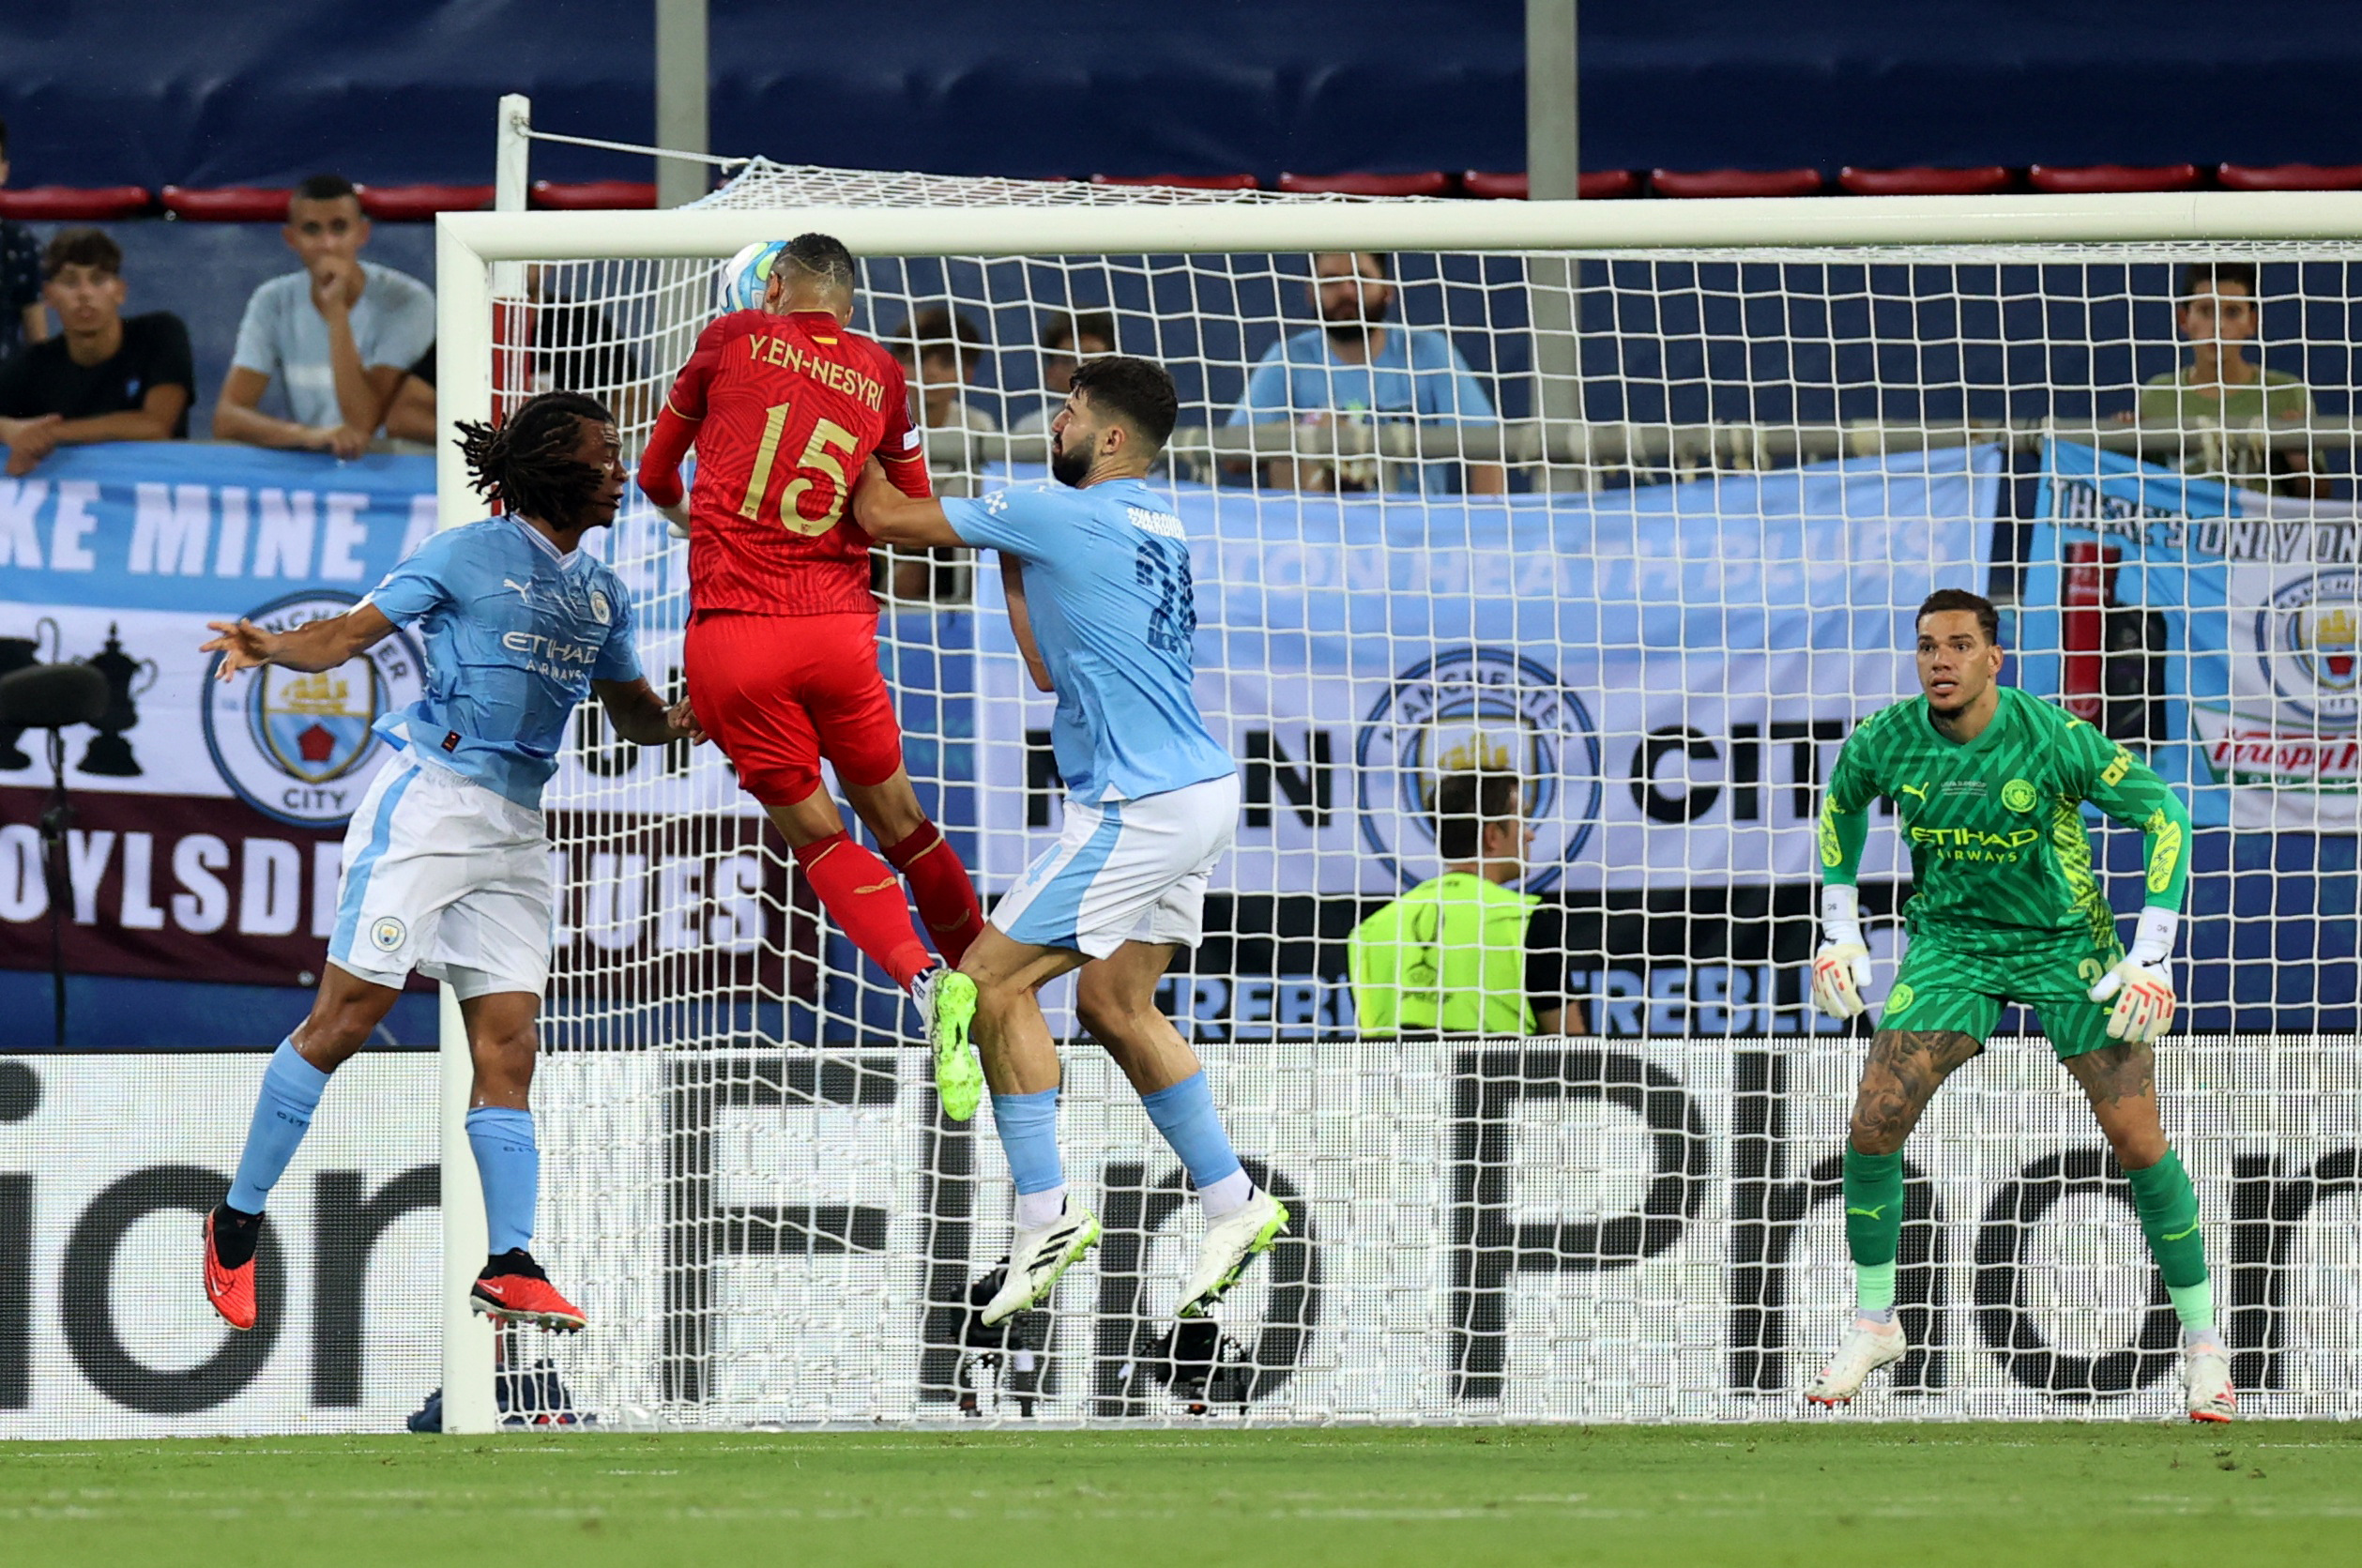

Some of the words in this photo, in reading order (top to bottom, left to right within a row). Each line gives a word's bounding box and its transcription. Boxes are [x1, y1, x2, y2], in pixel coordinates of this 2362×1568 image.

[750, 334, 885, 412] Y.EN-NESYRI
[738, 402, 860, 537] 15
[128, 482, 370, 580] MINE
[1194, 541, 1386, 599] TON
[1411, 536, 1687, 596] HEATH
[1703, 519, 1947, 591] BLUES
[2196, 515, 2302, 563] ONLY
[282, 787, 348, 810] CITY
[1629, 719, 1900, 823] CIT
[1911, 827, 2039, 848] ETIHAD
[1937, 848, 2018, 864] AIRWAYS
